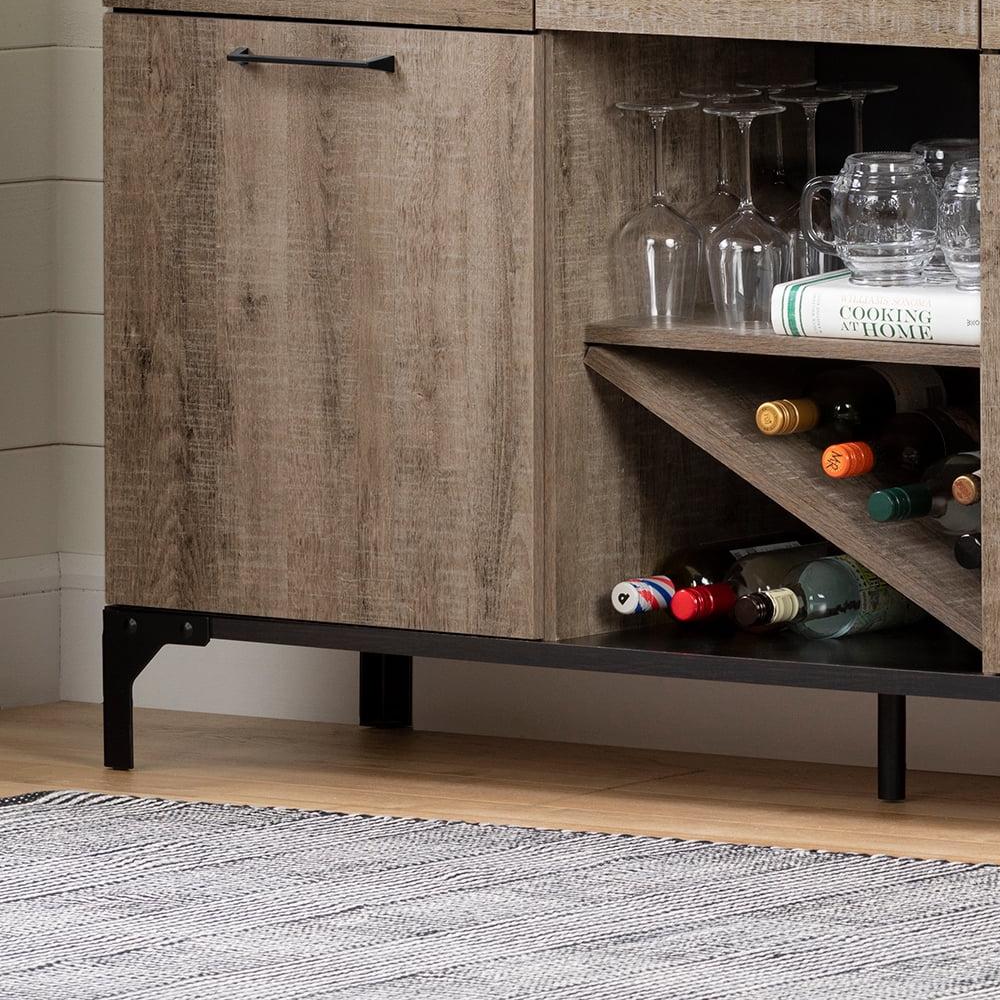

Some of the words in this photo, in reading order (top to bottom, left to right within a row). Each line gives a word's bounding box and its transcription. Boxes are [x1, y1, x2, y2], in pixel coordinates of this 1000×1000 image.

[839, 305, 933, 324] COOKING
[841, 322, 859, 332] AT
[862, 322, 933, 341] HOME
